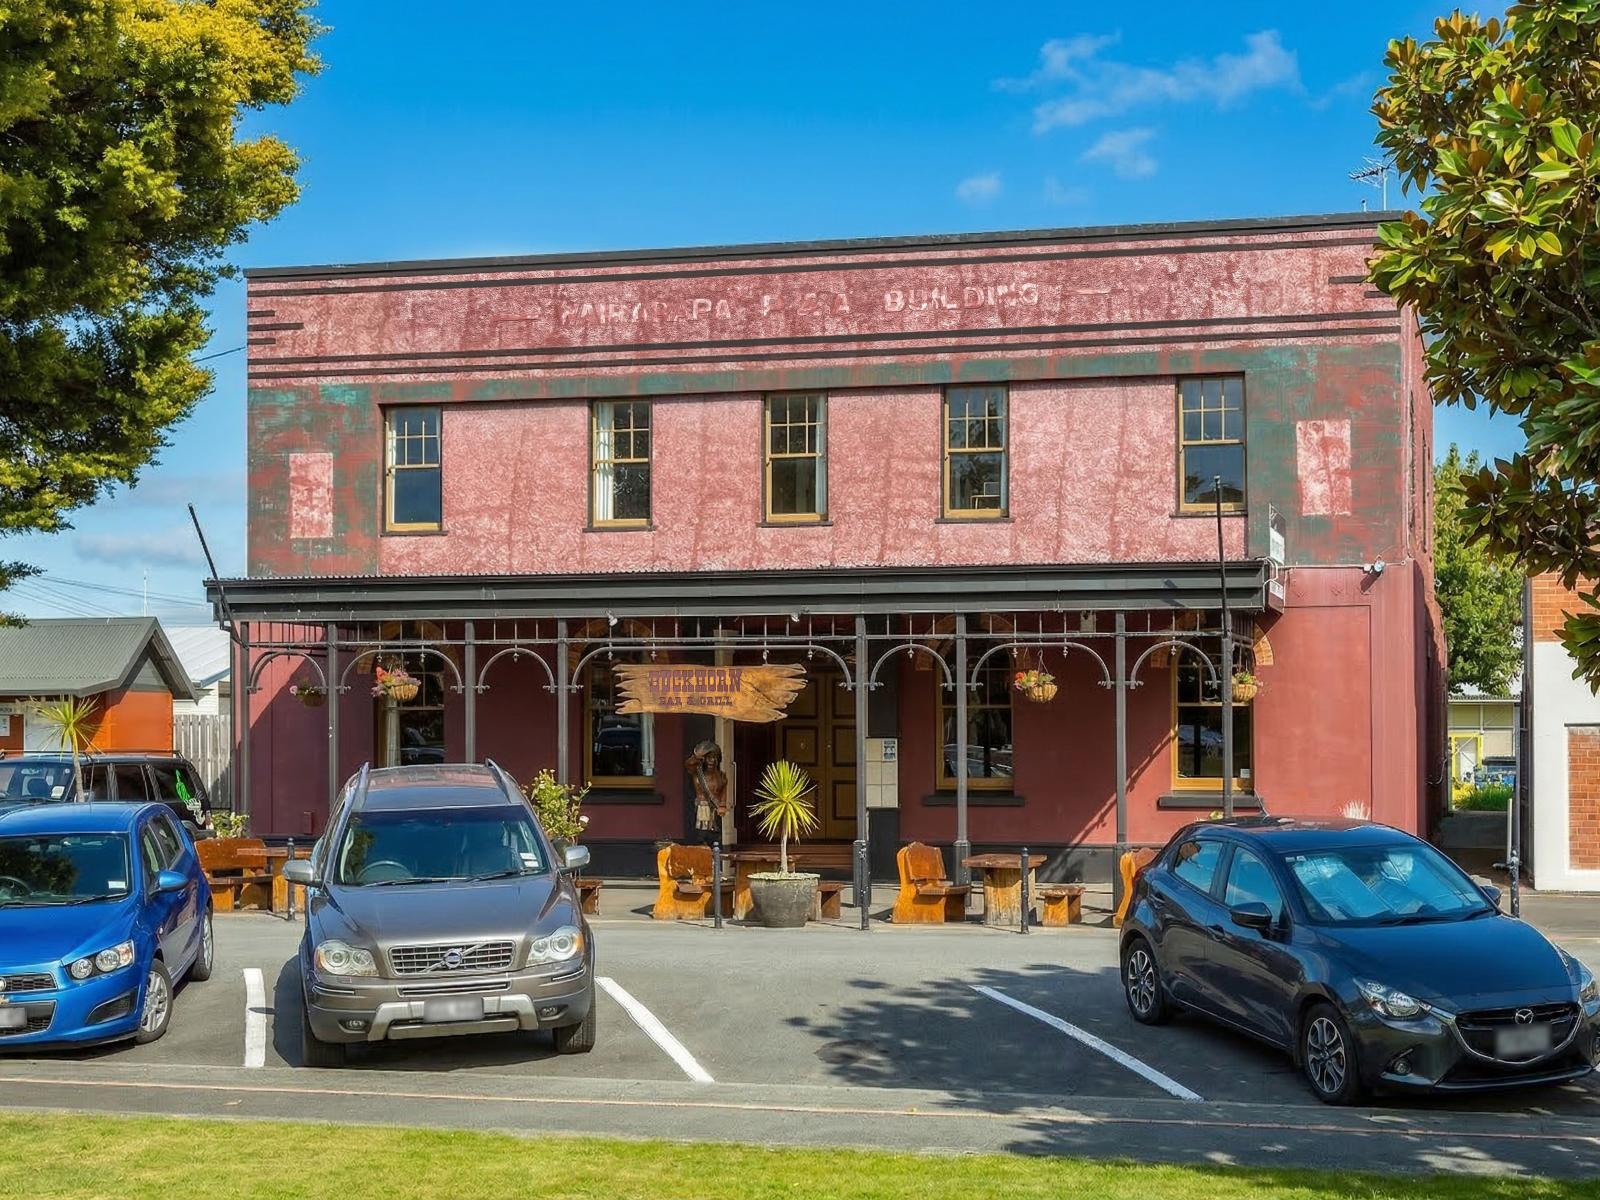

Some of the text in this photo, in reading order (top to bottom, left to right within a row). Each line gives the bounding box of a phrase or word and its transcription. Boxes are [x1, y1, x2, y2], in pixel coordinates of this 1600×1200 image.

[884, 283, 1039, 312] BUILDING
[649, 669, 741, 692] BUCKHORN
[659, 696, 733, 706] BAR & GRILL
